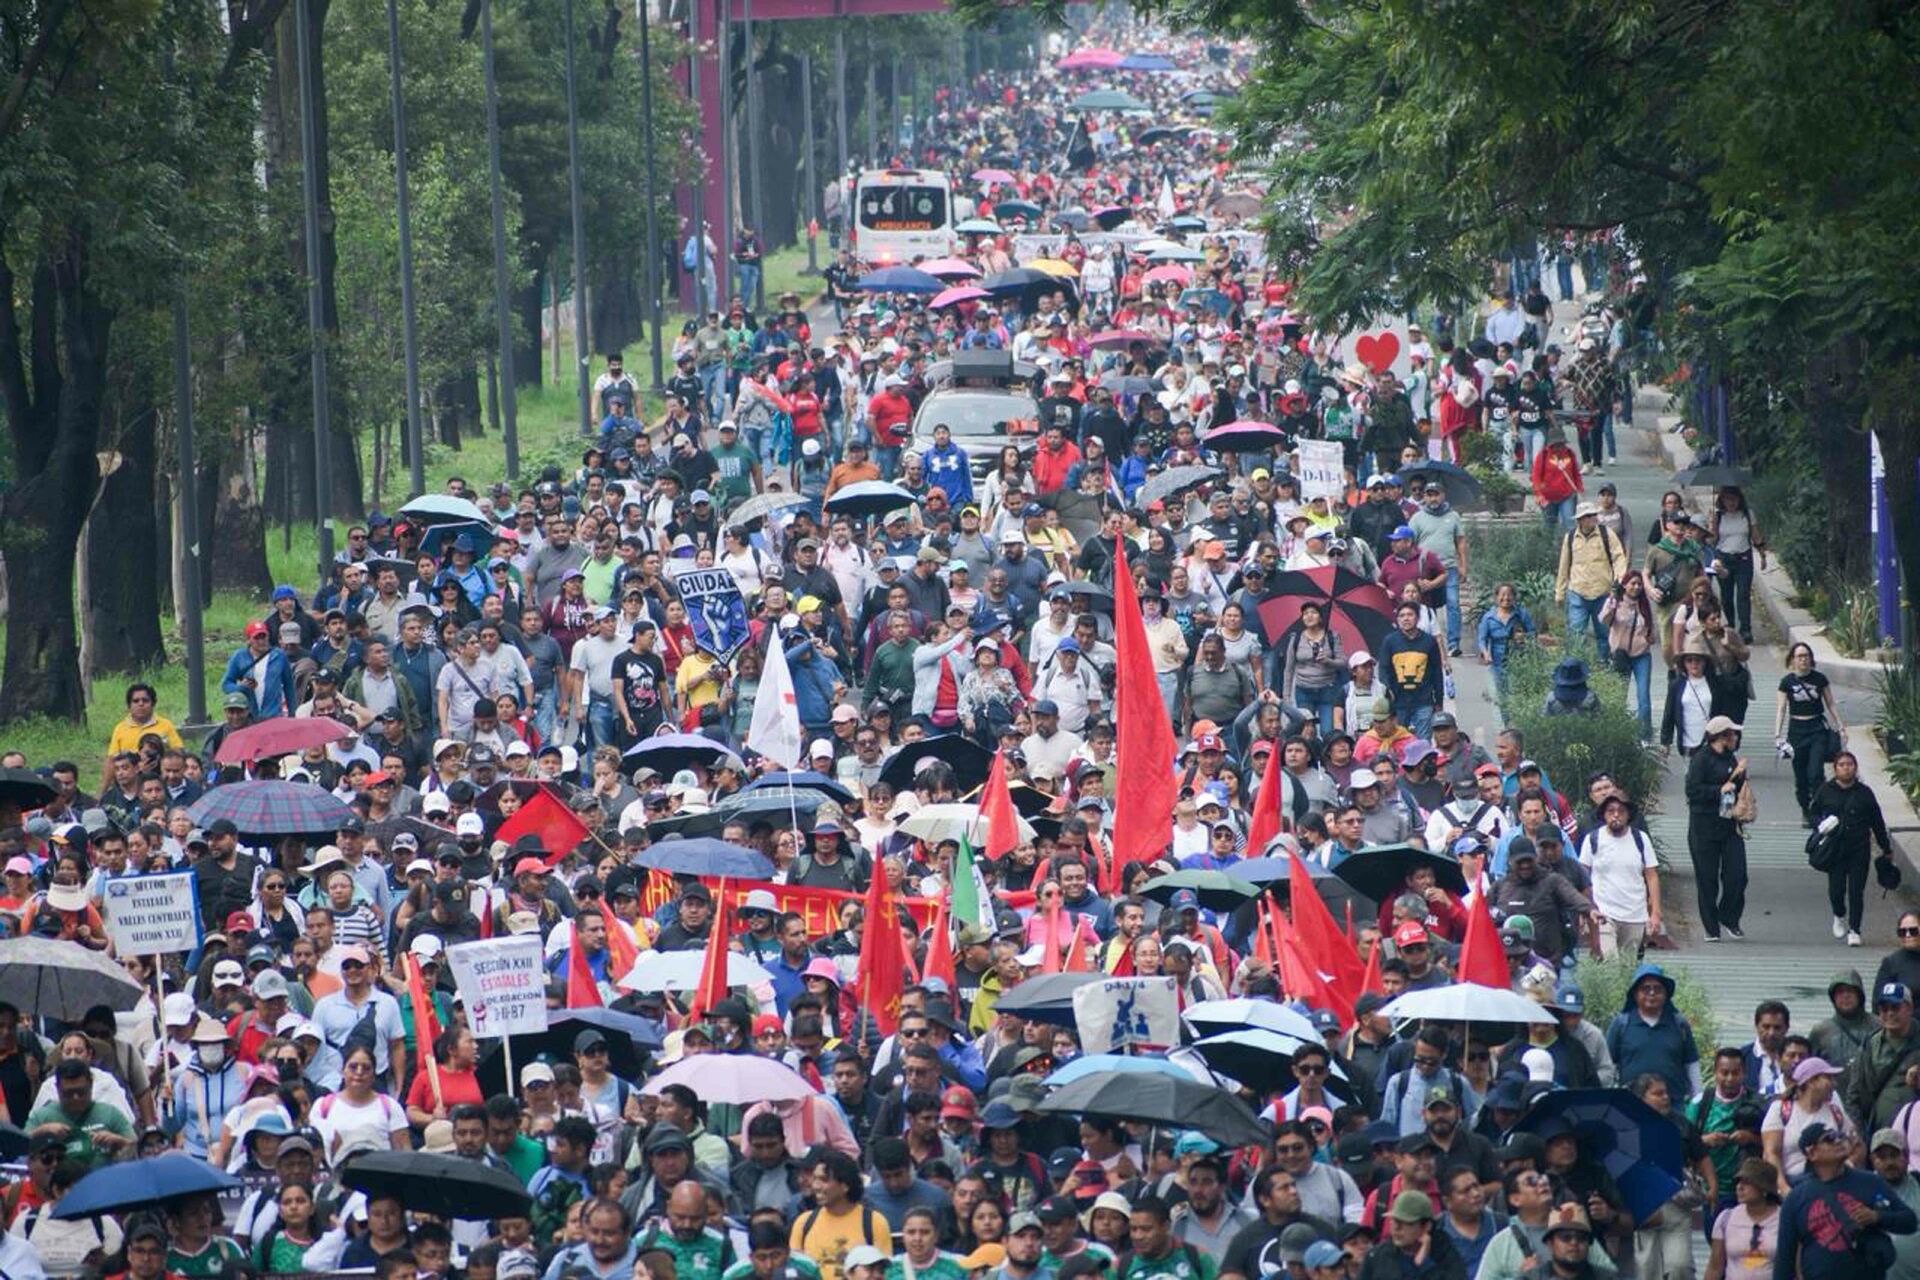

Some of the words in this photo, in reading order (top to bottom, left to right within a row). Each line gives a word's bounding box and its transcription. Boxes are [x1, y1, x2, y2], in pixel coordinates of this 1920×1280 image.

[134, 880, 167, 892] SECTOR
[131, 895, 175, 909] ESTATALES
[118, 914, 147, 926] VALLES
[147, 910, 192, 925] CENTRALES
[512, 957, 533, 971] XXII
[481, 972, 529, 992] ESTATALES
